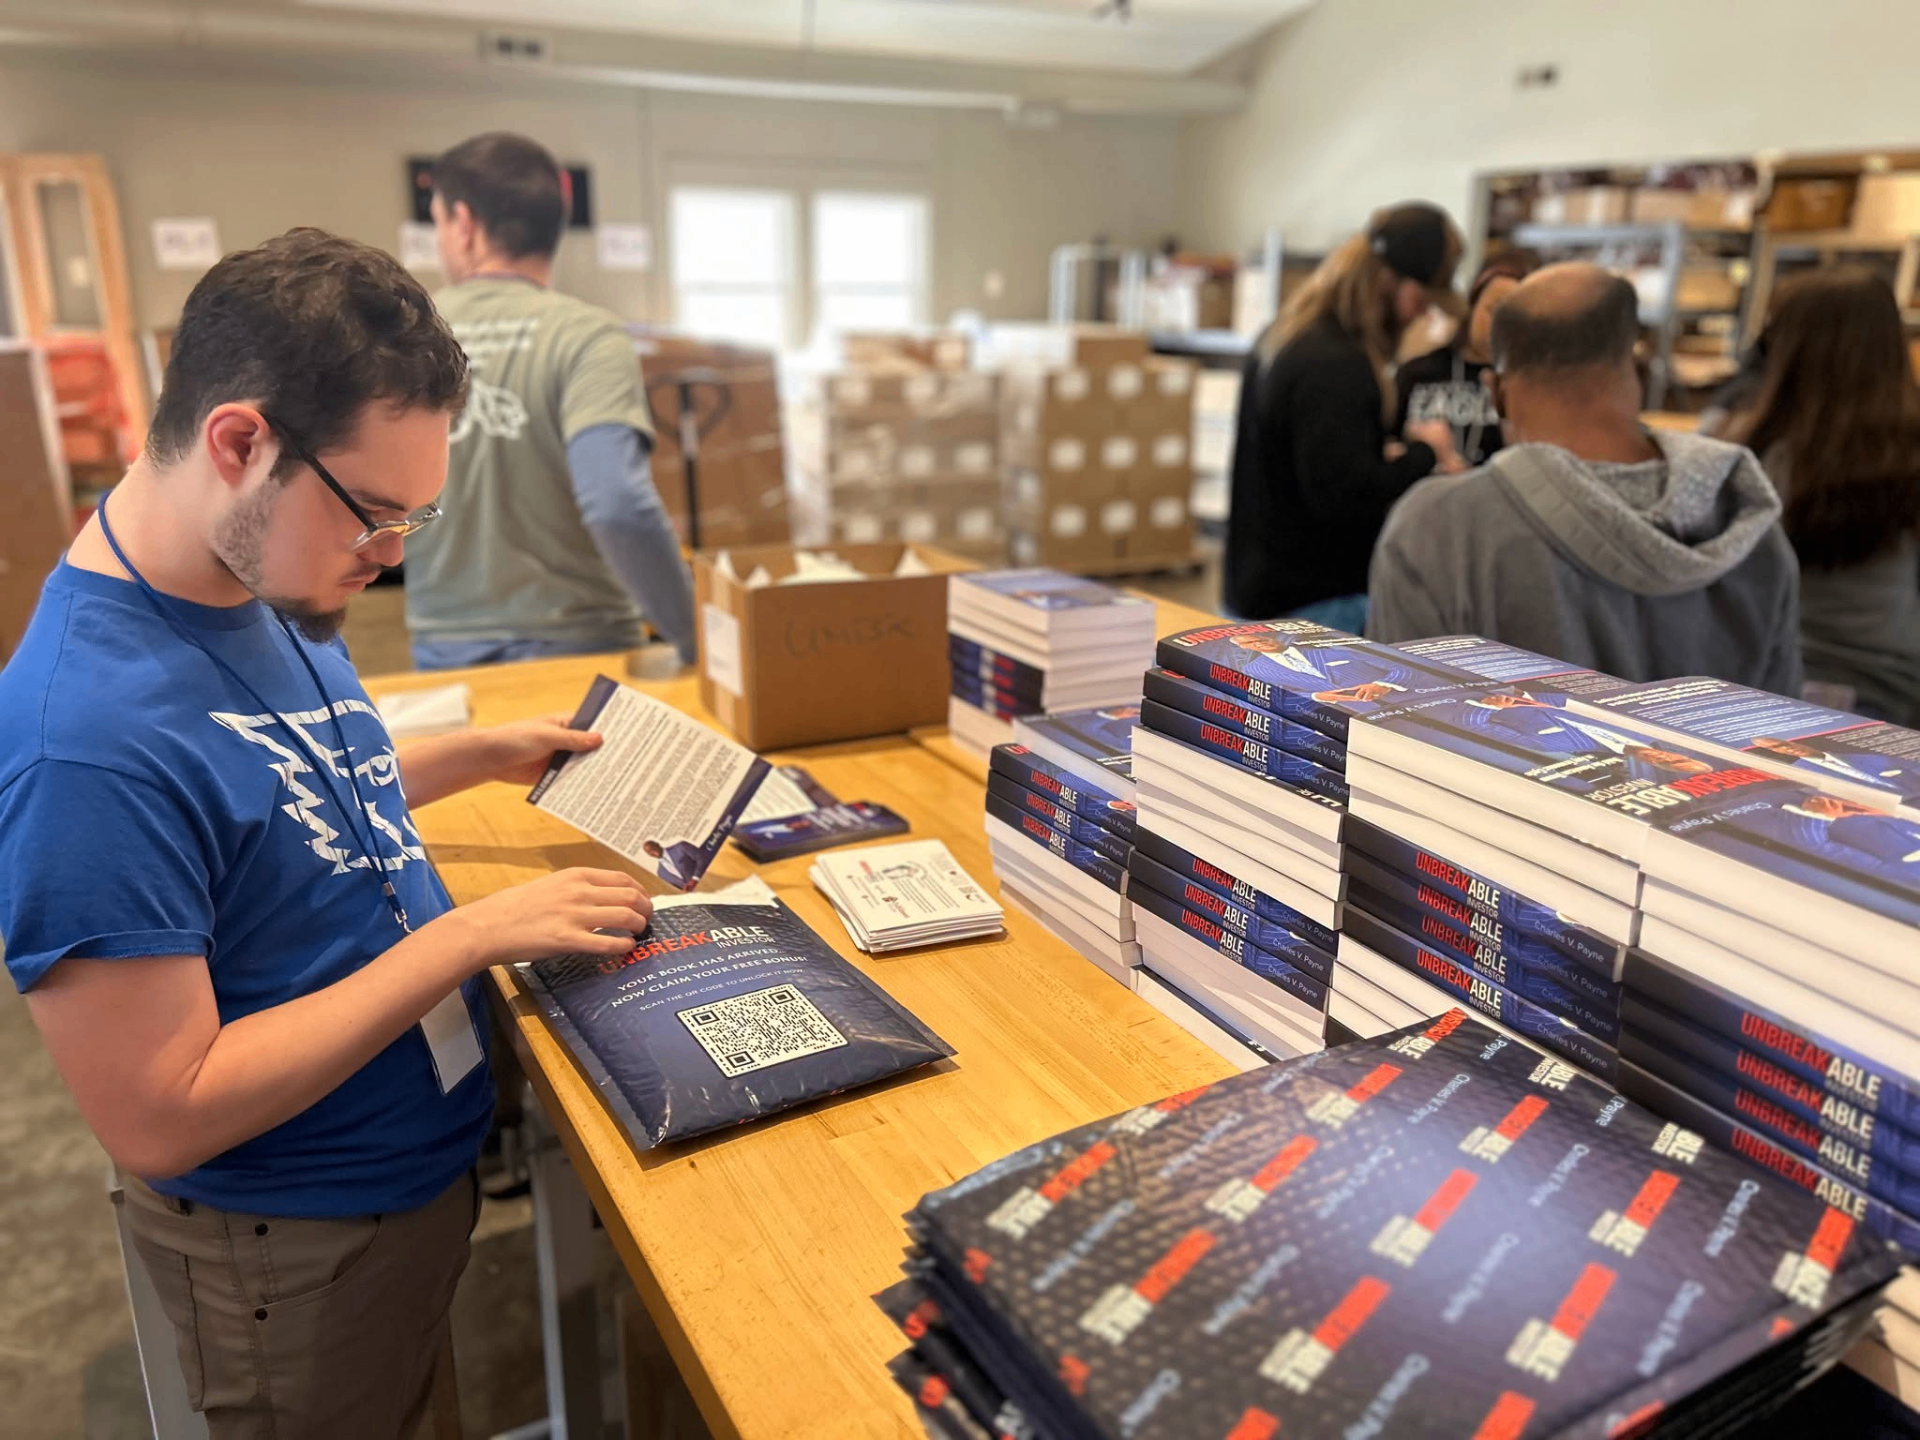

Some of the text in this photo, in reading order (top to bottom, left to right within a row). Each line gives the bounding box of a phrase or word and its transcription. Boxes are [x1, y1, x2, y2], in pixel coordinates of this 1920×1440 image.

[1172, 621, 1318, 647] UNBREAKABLE
[1210, 663, 1271, 701] UNBREAKABLE
[1202, 696, 1270, 733] UNBREAKABLE
[1201, 724, 1268, 763] UNBREAKABLE
[1244, 726, 1269, 742] INVESTOR
[1297, 736, 1321, 753] Charles
[1330, 749, 1346, 762] Pay
[1242, 756, 1268, 773] INVESTOR
[1031, 770, 1077, 804] UNBREAKABLE
[1296, 768, 1320, 786] Charles
[1329, 781, 1349, 796] Payne
[1584, 778, 1656, 802] INVESTOR
[1606, 768, 1781, 816] BREAKABLE
[1026, 793, 1071, 827] UNBREAKABLE
[1668, 815, 1714, 832] Payne
[1722, 802, 1772, 817] Charles
[1023, 816, 1066, 850] UNBREAKABLE
[1192, 858, 1256, 902] UNBREAKABLE
[1415, 851, 1500, 909] UNBREAKABLE
[1184, 884, 1248, 930] UNBREAKABLE
[1231, 894, 1255, 911] INVESTOR
[1417, 884, 1503, 942] UNBREAKABLE
[1467, 897, 1499, 918] INVESTOR
[716, 936, 776, 949] INVESTOR
[1181, 909, 1245, 956] UNBREAKABLE
[1222, 920, 1247, 938] INVESTOR
[1422, 914, 1507, 975] UNBREAKABLE
[1469, 930, 1502, 951] INVESTOR
[1534, 920, 1565, 943] Charles
[1577, 942, 1604, 963] Payne
[1219, 946, 1243, 963] INVESTOR
[1273, 938, 1296, 956] Charles
[1304, 955, 1324, 971] Payne
[611, 956, 808, 1008] NOW CLAIM YOUR FREE BONUS!
[617, 974, 657, 991] YOUR
[658, 963, 698, 977] BOOK
[699, 956, 725, 967] HAS
[1268, 964, 1291, 984] Charles
[1299, 982, 1318, 999] Payne
[1417, 949, 1503, 1010] UNBREAKABLE
[1473, 963, 1506, 986] INVESTOR
[1538, 954, 1569, 978] Charles
[1580, 978, 1608, 999] Payne
[639, 1000, 665, 1011] SCAN
[666, 994, 684, 1002] THE
[699, 982, 724, 993] CODE
[738, 972, 773, 983] UNLOCK
[1469, 996, 1501, 1019] INVESTOR
[1542, 987, 1573, 1012] Charles
[1584, 1011, 1613, 1032] Payne
[1479, 1038, 1509, 1061] Payne
[1537, 1023, 1568, 1047] Charles
[1580, 1046, 1608, 1068] Payne
[1740, 1012, 1882, 1101] UNBREAKABLE
[1437, 1074, 1471, 1099] Charles
[1736, 1050, 1875, 1141] UNBREAKABLE
[1595, 1099, 1625, 1127] Payne
[1735, 1087, 1873, 1179] UNBREAKABLE
[1731, 1127, 1868, 1222] UNBREAKABLE
